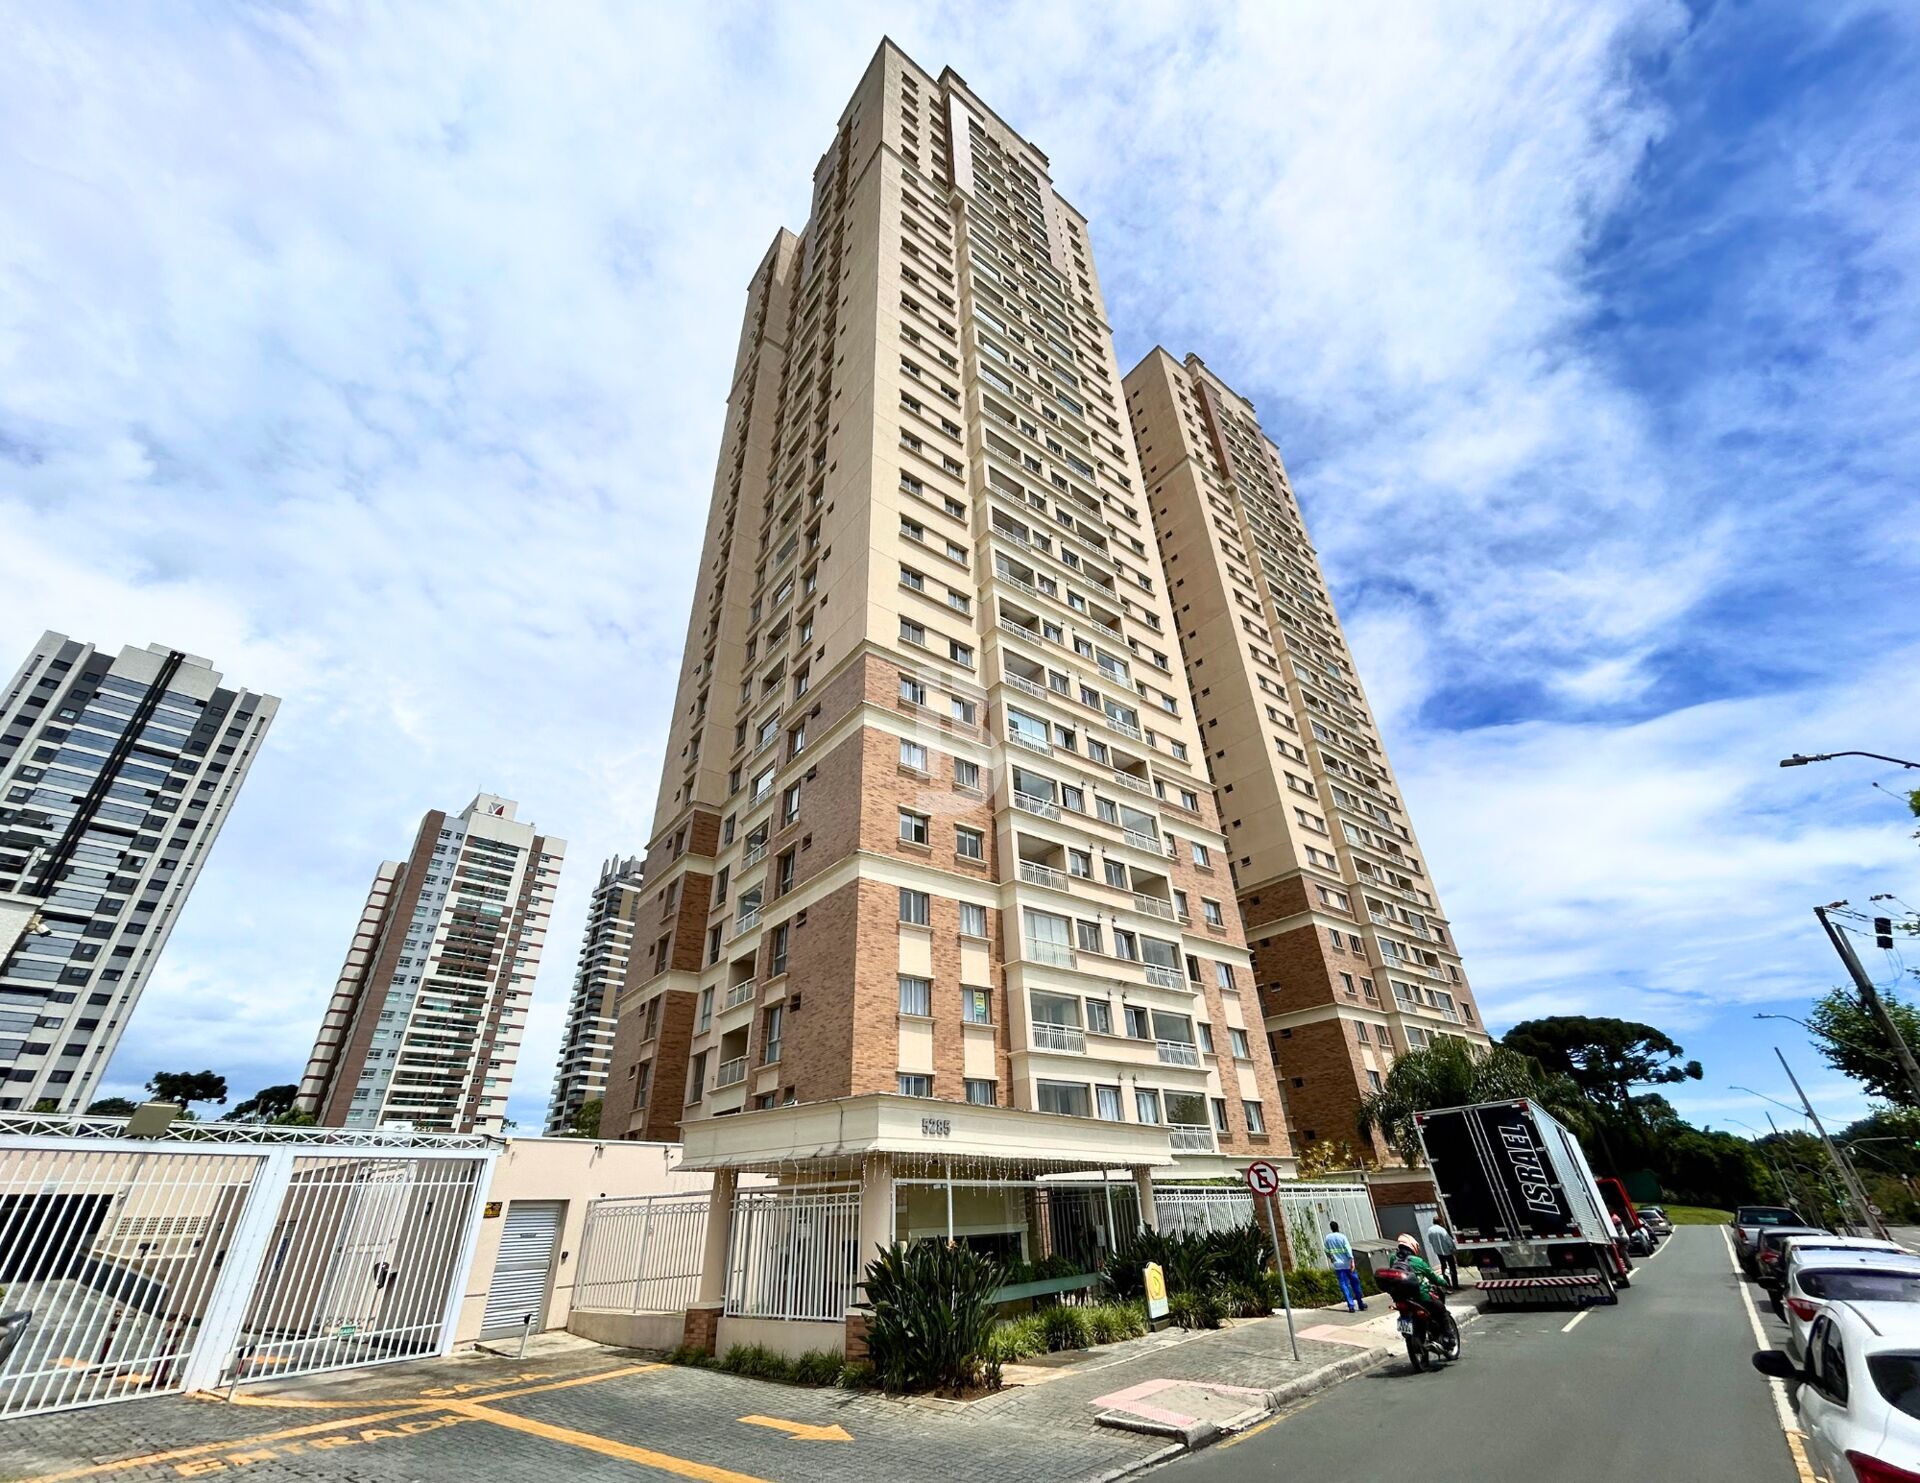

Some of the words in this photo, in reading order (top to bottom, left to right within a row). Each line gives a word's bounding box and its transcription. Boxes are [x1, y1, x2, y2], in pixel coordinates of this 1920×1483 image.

[921, 1118, 951, 1136] 5285
[1256, 1168, 1271, 1189] E
[1498, 1124, 1560, 1214] ISRAEL
